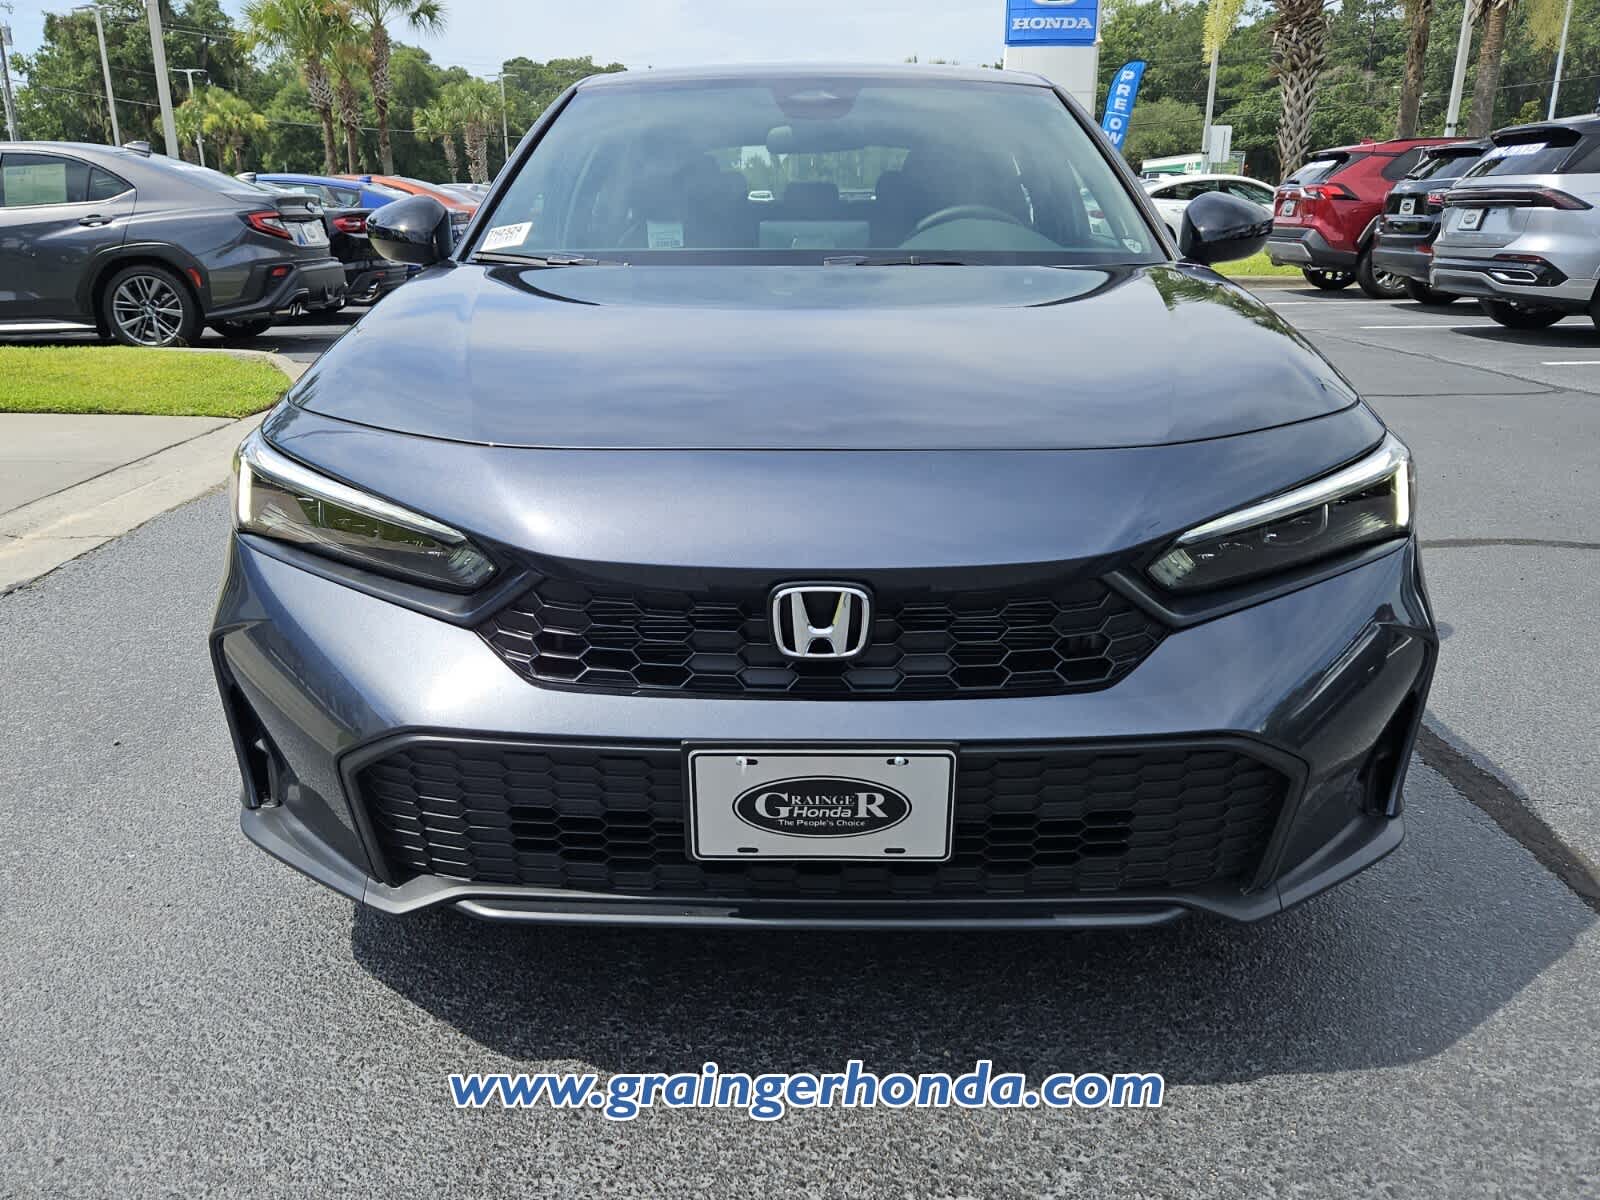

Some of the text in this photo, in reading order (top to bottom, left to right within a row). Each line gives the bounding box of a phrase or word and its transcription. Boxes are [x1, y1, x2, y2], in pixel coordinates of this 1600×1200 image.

[1012, 17, 1093, 30] HONDA
[1114, 70, 1135, 110] PRE
[754, 792, 889, 819] GRAINGER
[793, 806, 851, 818] Honda
[796, 819, 834, 827] People's
